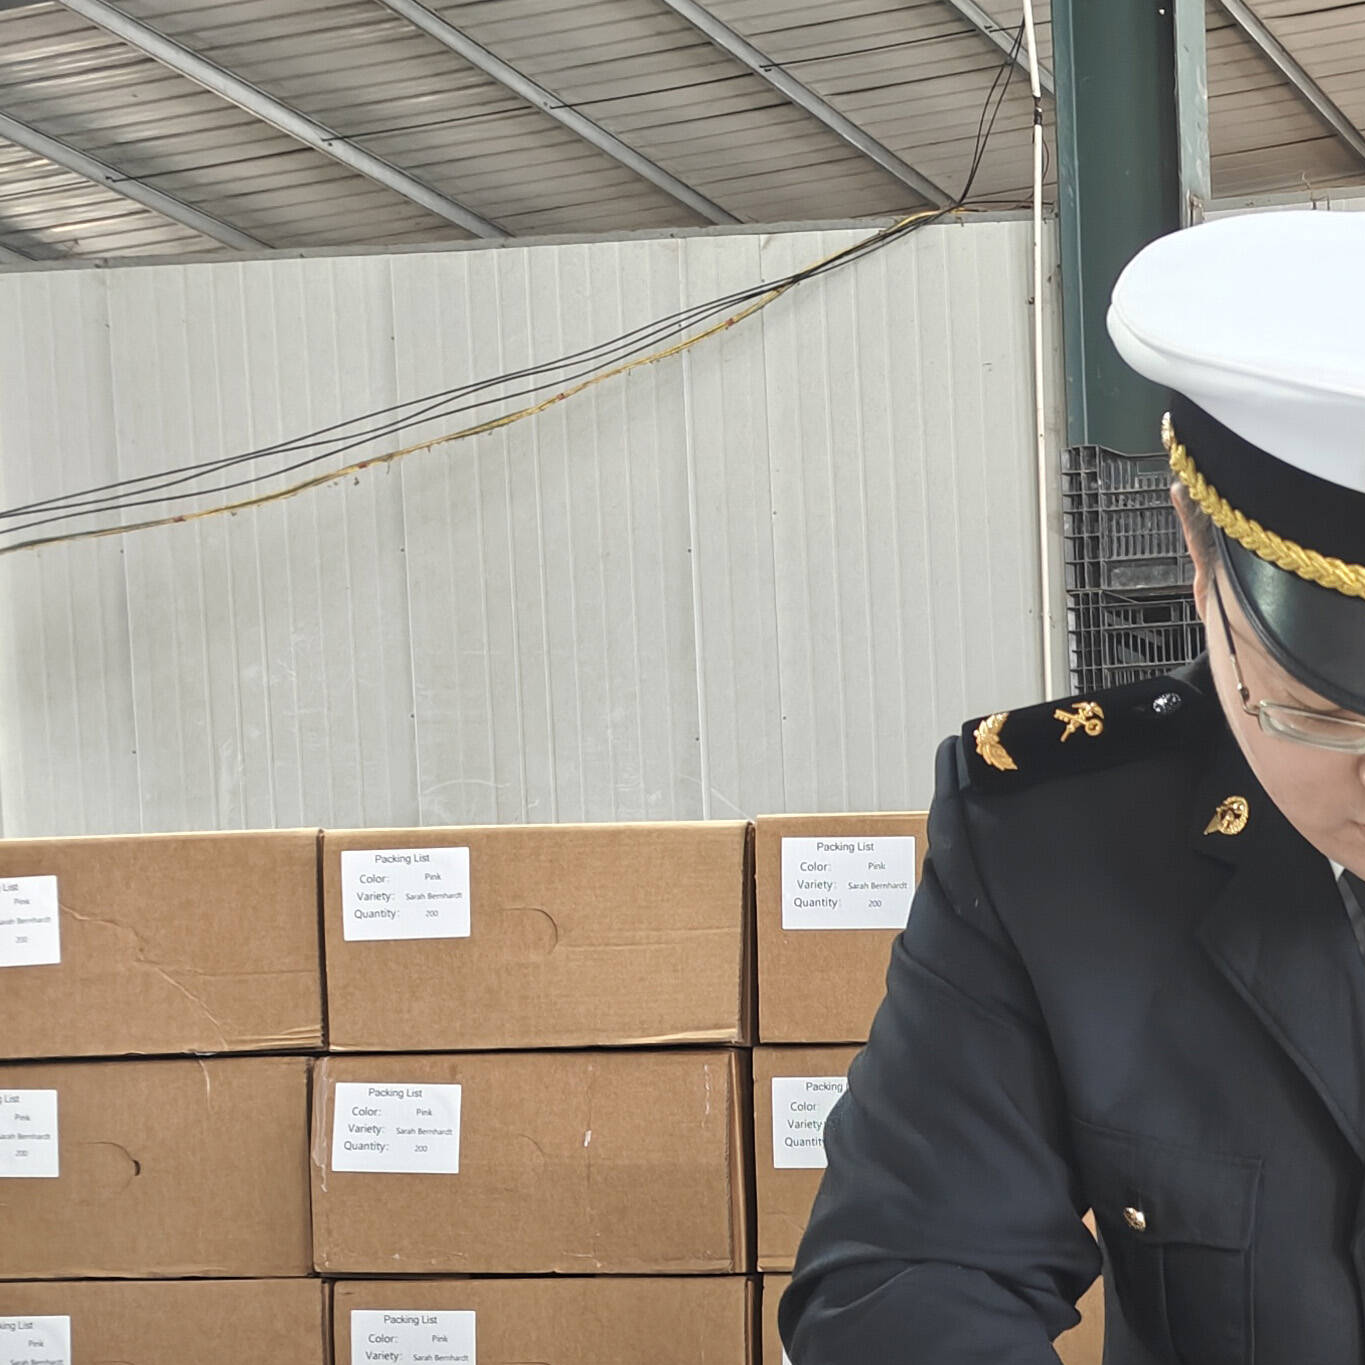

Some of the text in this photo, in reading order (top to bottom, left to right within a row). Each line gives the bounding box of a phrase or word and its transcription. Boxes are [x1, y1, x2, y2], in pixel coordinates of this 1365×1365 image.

[816, 842, 874, 854] Packing List
[374, 853, 430, 865] Packing List
[868, 862, 886, 870] Pink
[424, 872, 442, 881] Pink
[868, 900, 882, 908] 200
[425, 910, 439, 918] 200
[805, 1081, 843, 1093] Packing
[368, 1087, 423, 1099] Packing List
[416, 1108, 432, 1116] Pink
[784, 1136, 823, 1147] Quantit
[383, 1314, 437, 1326] Packing List
[431, 1334, 448, 1342] Pink
